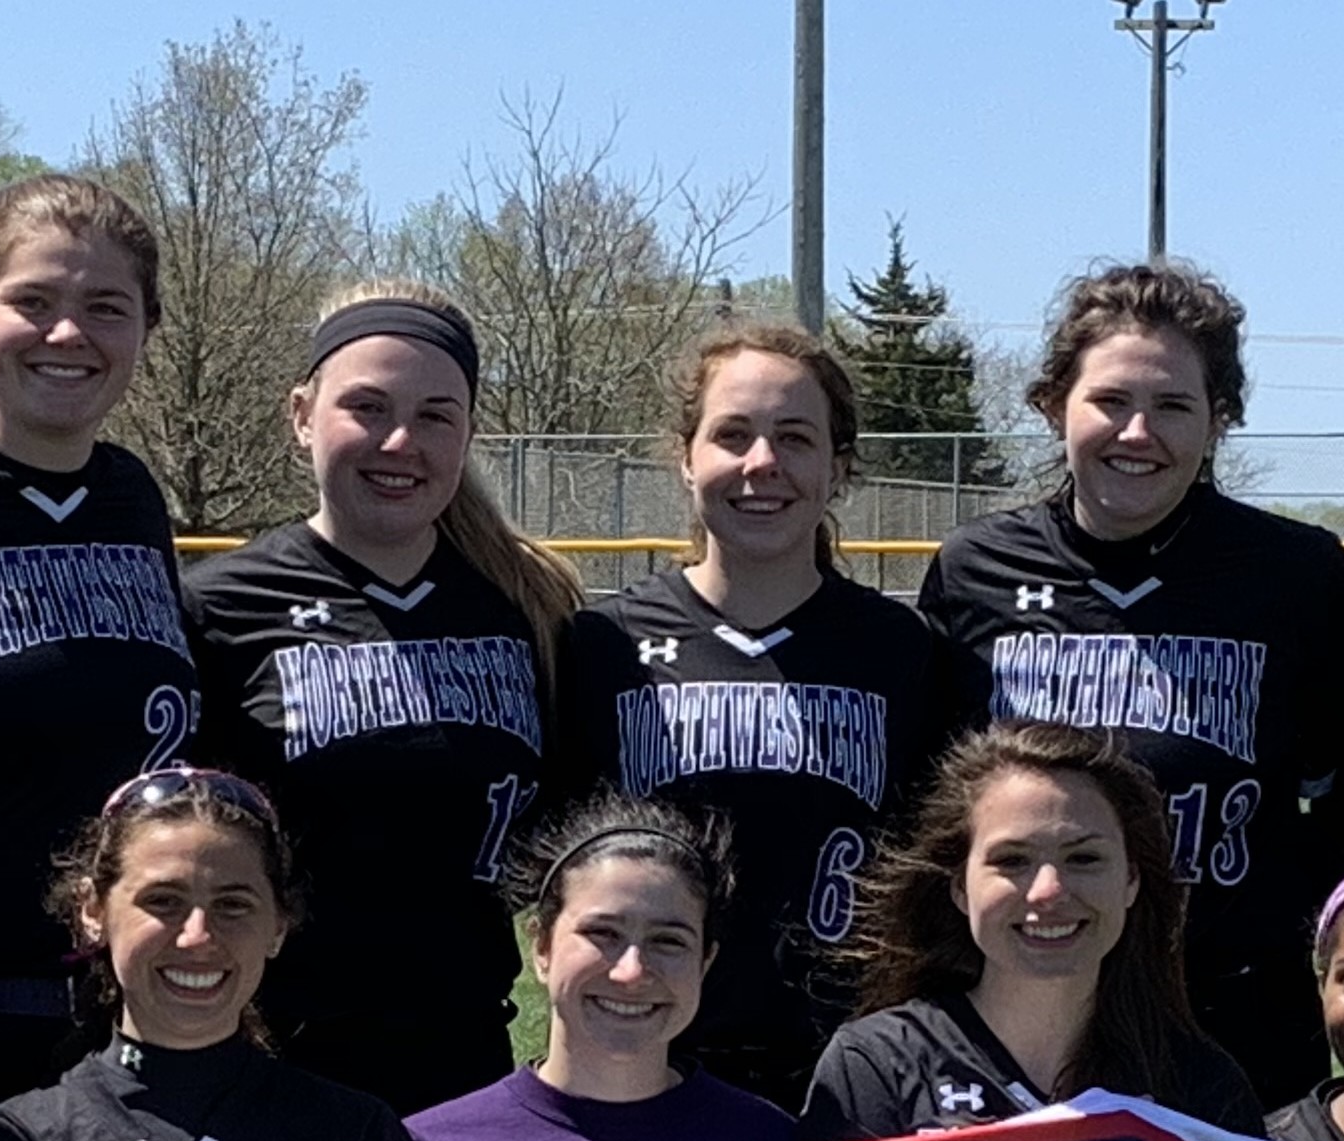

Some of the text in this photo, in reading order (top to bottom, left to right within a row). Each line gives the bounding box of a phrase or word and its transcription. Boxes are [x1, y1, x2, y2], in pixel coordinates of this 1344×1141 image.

[617, 681, 887, 812] NORTHWESTERN
[807, 826, 864, 942] 6
[1168, 778, 1261, 886] 13
